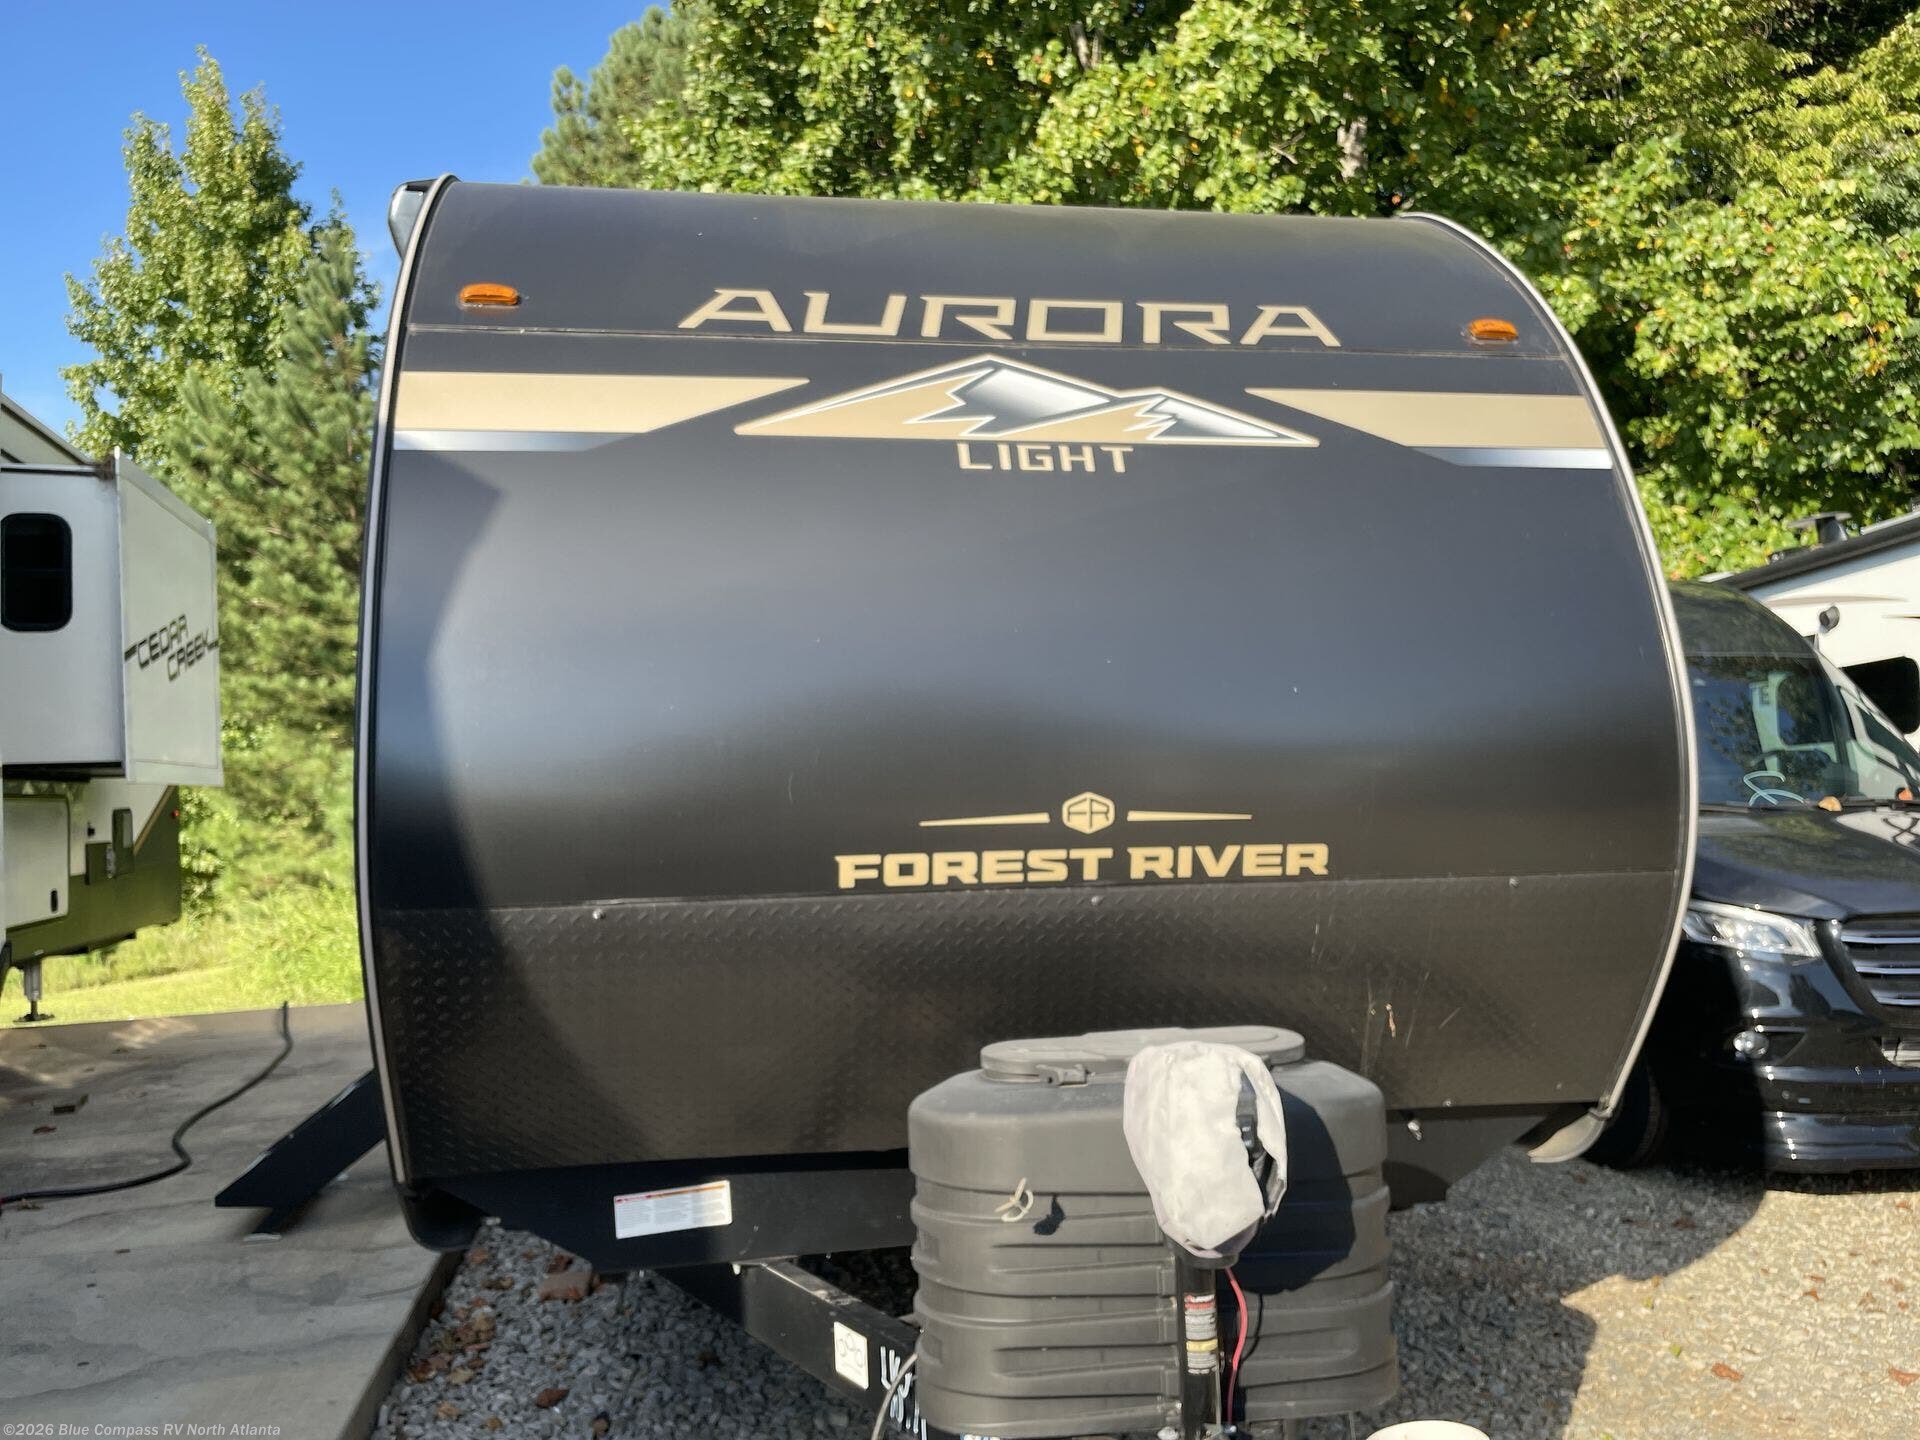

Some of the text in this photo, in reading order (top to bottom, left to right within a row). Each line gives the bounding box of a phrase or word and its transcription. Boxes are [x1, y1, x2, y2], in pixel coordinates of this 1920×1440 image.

[677, 288, 1342, 348] AURORA
[956, 442, 1134, 474] LIGHT
[137, 613, 189, 670] CEDAR
[167, 627, 210, 682] CREEK
[834, 842, 1330, 889] FOREST RIVER
